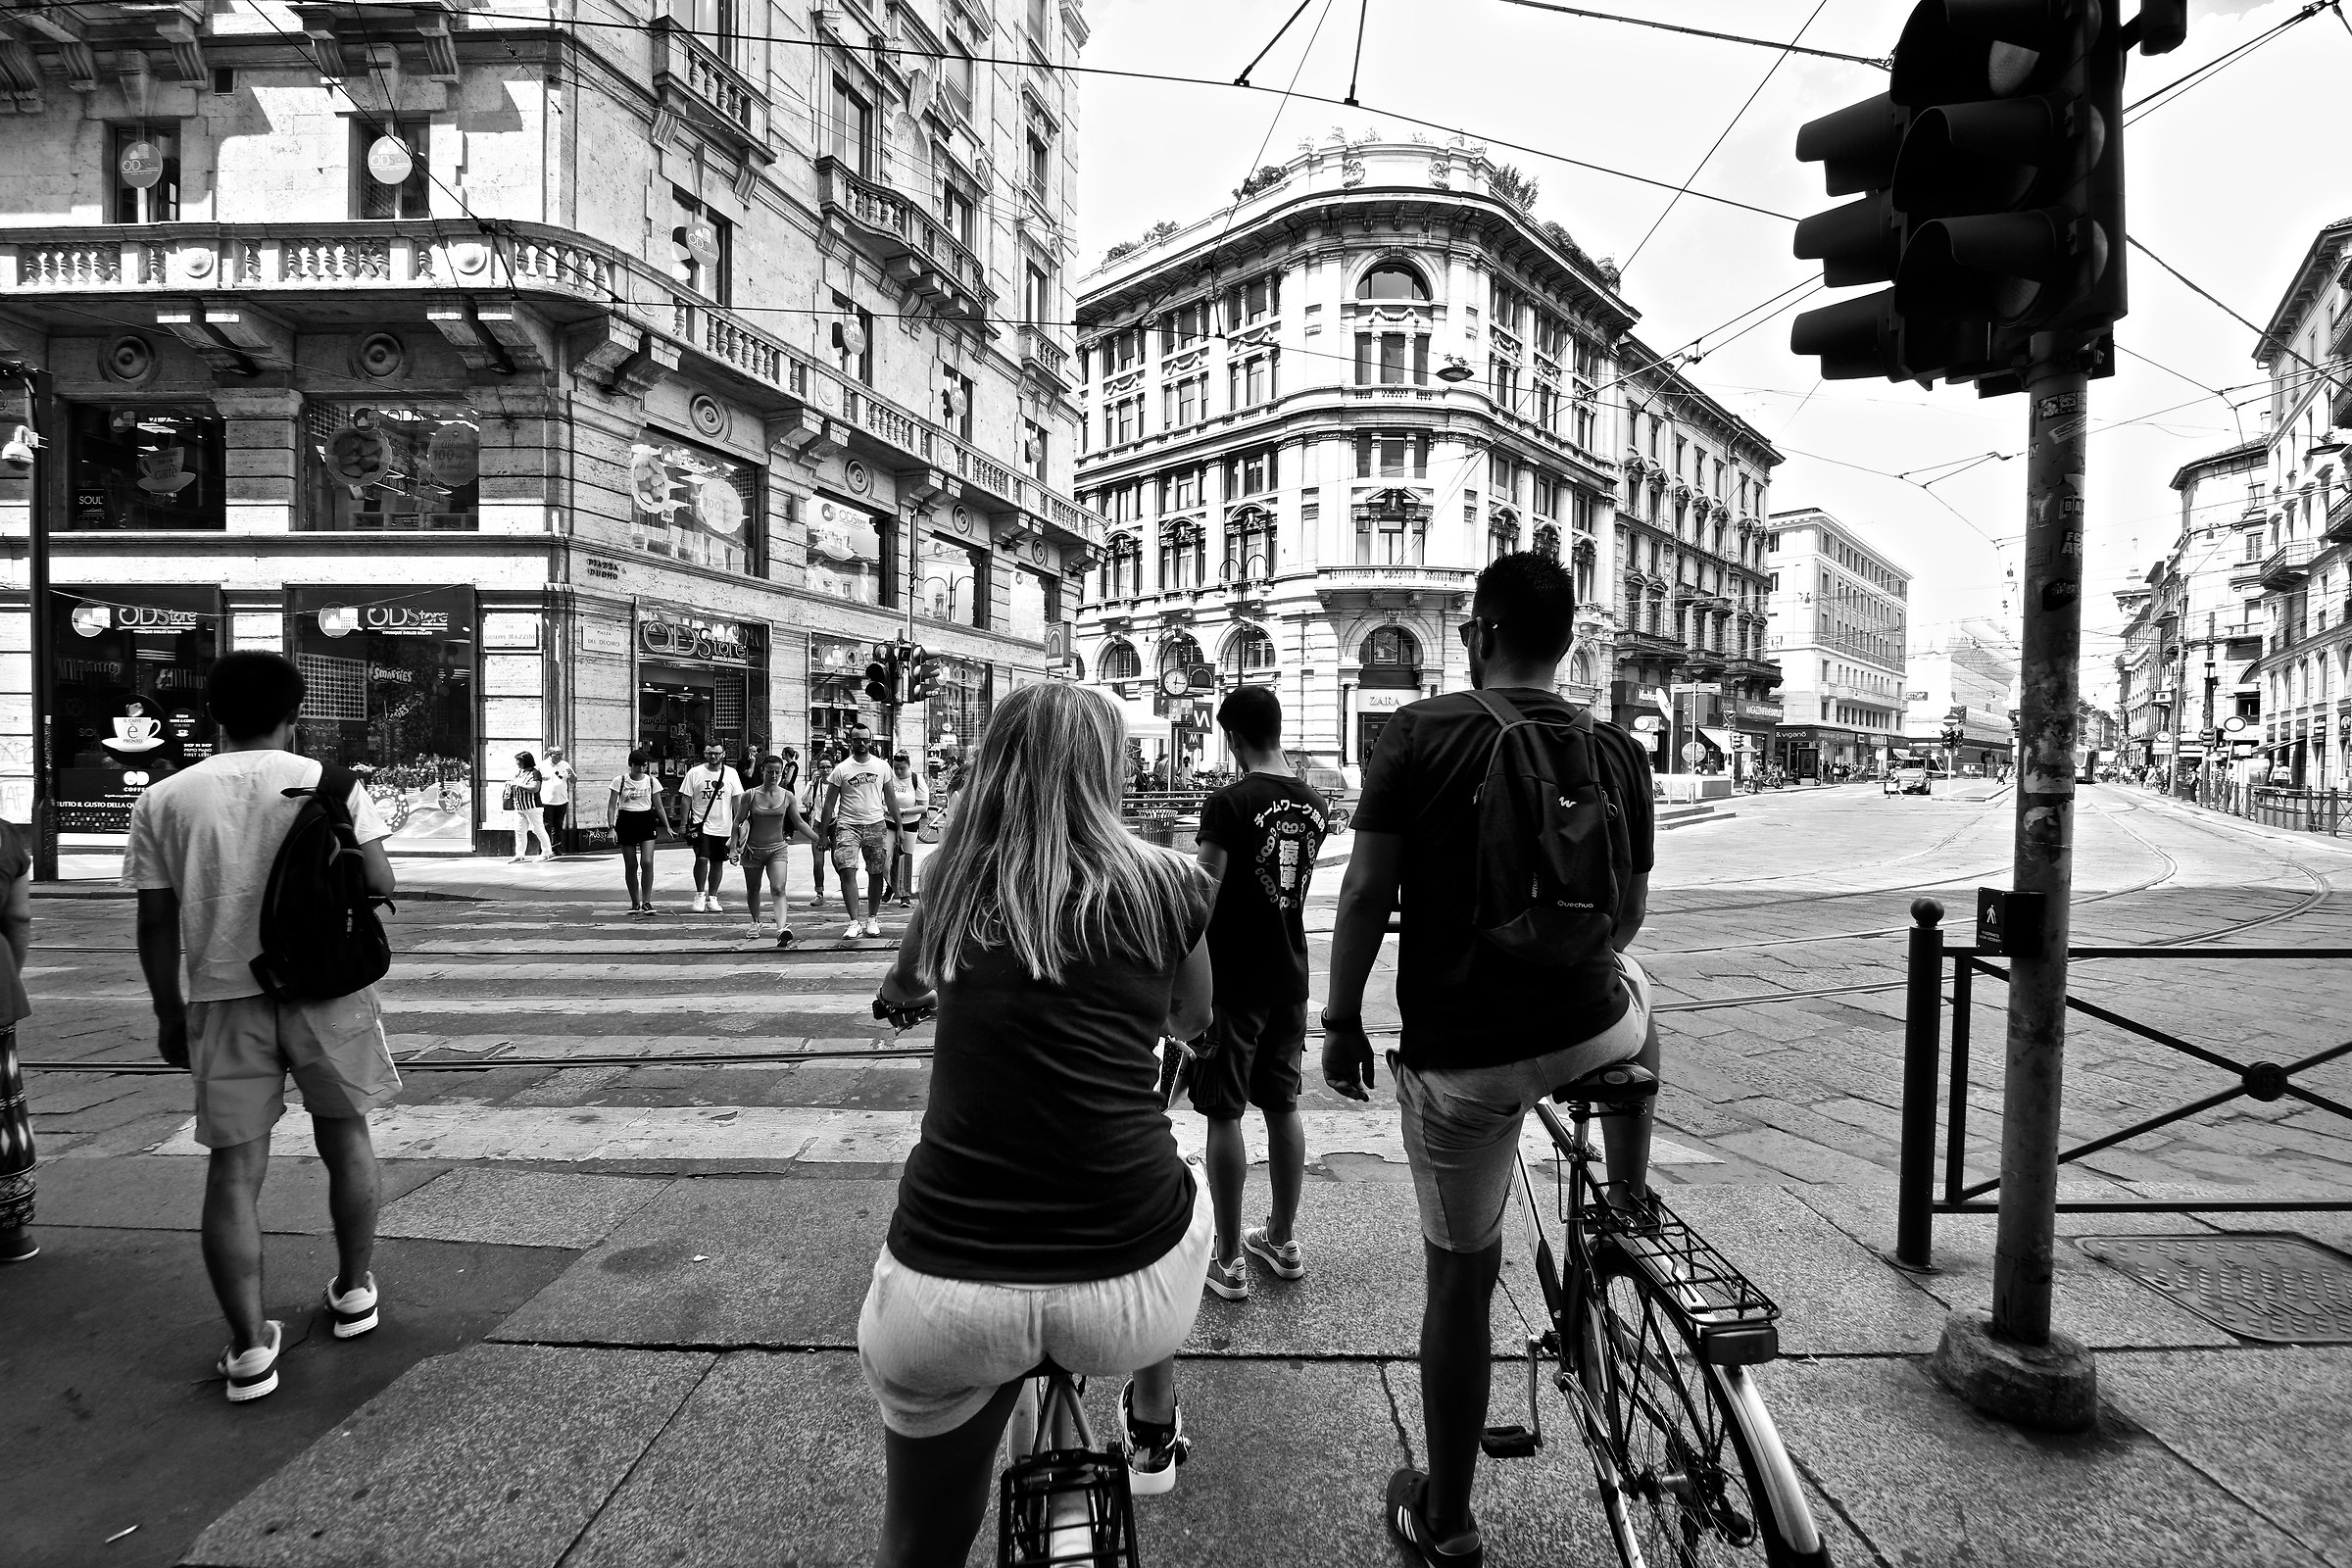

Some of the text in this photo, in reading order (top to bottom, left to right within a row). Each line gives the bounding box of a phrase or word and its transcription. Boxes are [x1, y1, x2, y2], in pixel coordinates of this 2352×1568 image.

[433, 449, 454, 462] 100
[78, 495, 101, 505] SOUL
[588, 558, 619, 571] PIAZZA
[119, 605, 196, 625] ODStore
[368, 605, 448, 626] ODStore
[599, 639, 620, 648] DUOMO
[643, 619, 746, 660] ODStore
[372, 666, 414, 683] SMARTIES
[1369, 696, 1401, 706] ZARA
[1556, 900, 1594, 908] Quechua
